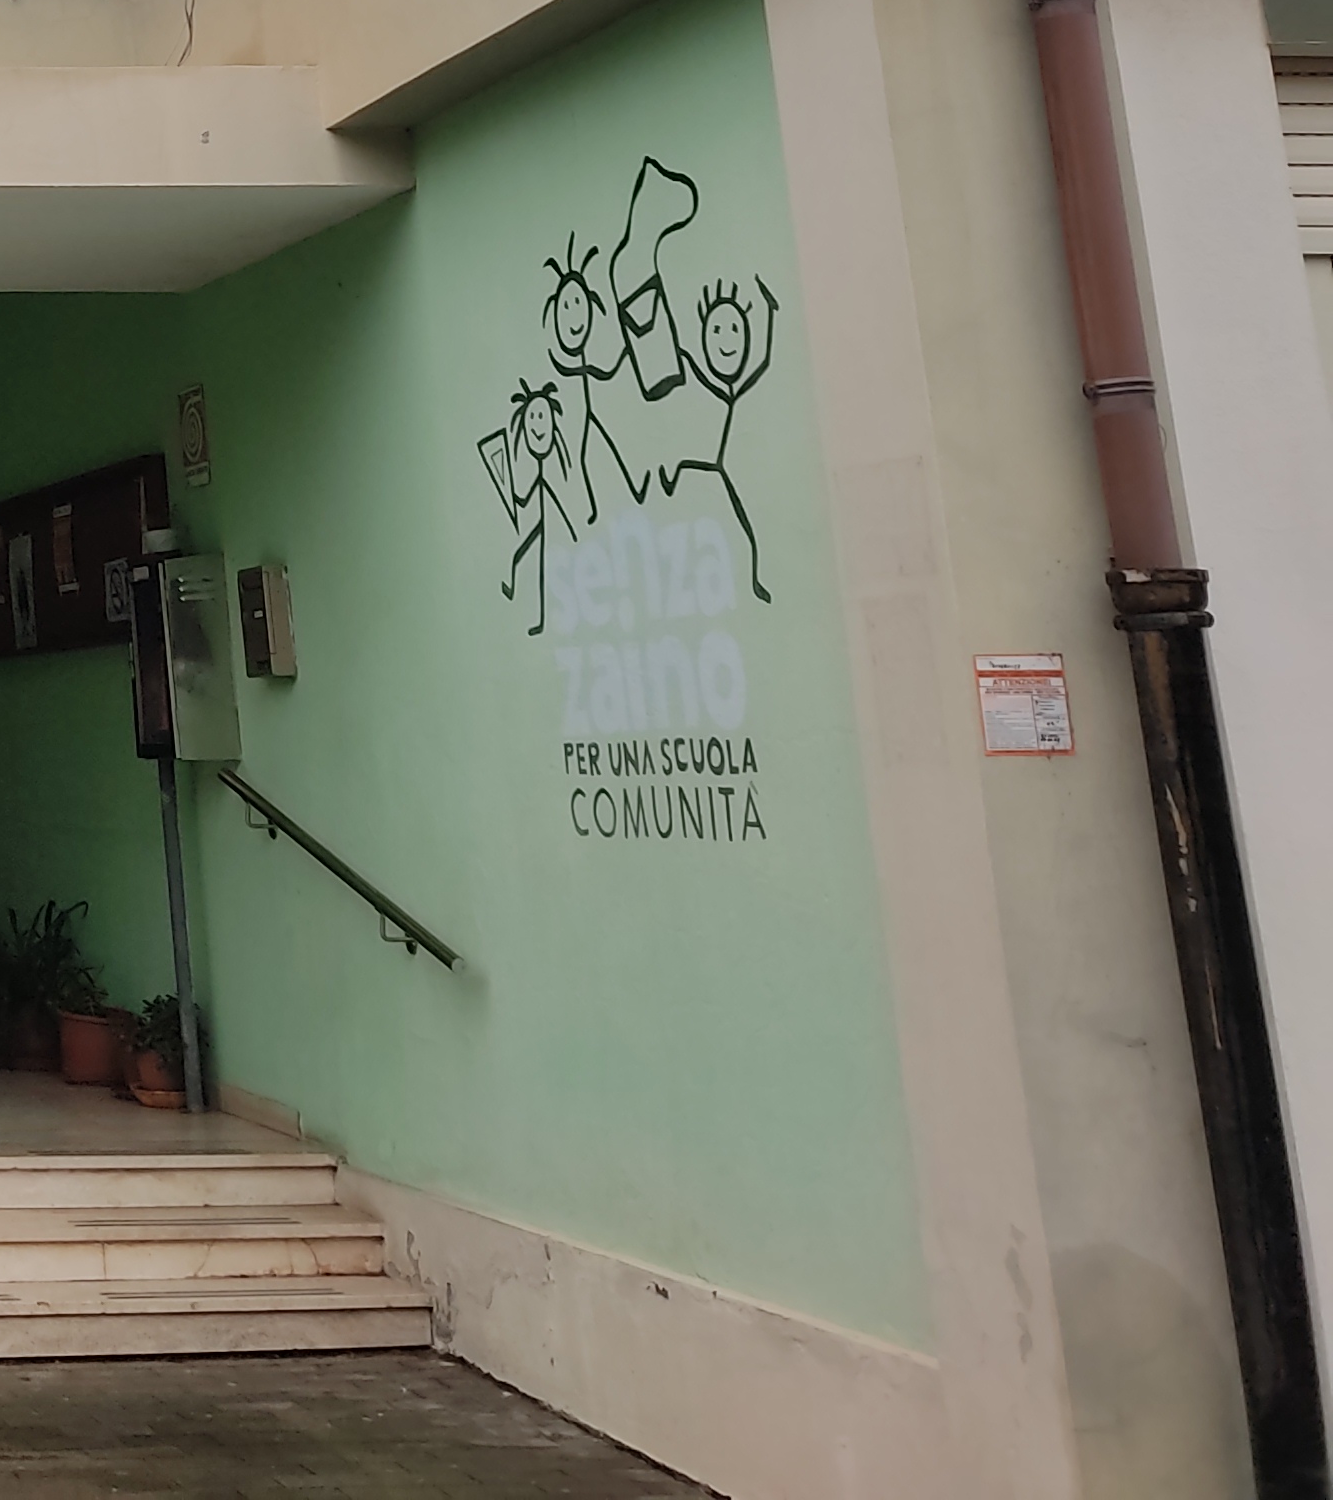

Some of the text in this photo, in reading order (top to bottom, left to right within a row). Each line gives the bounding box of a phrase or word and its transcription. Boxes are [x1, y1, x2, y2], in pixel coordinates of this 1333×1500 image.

[547, 507, 737, 633] senza
[555, 630, 747, 736] zaino
[563, 736, 759, 777] PER UNA SCUOLA
[570, 780, 768, 842] COMUNITÀ
